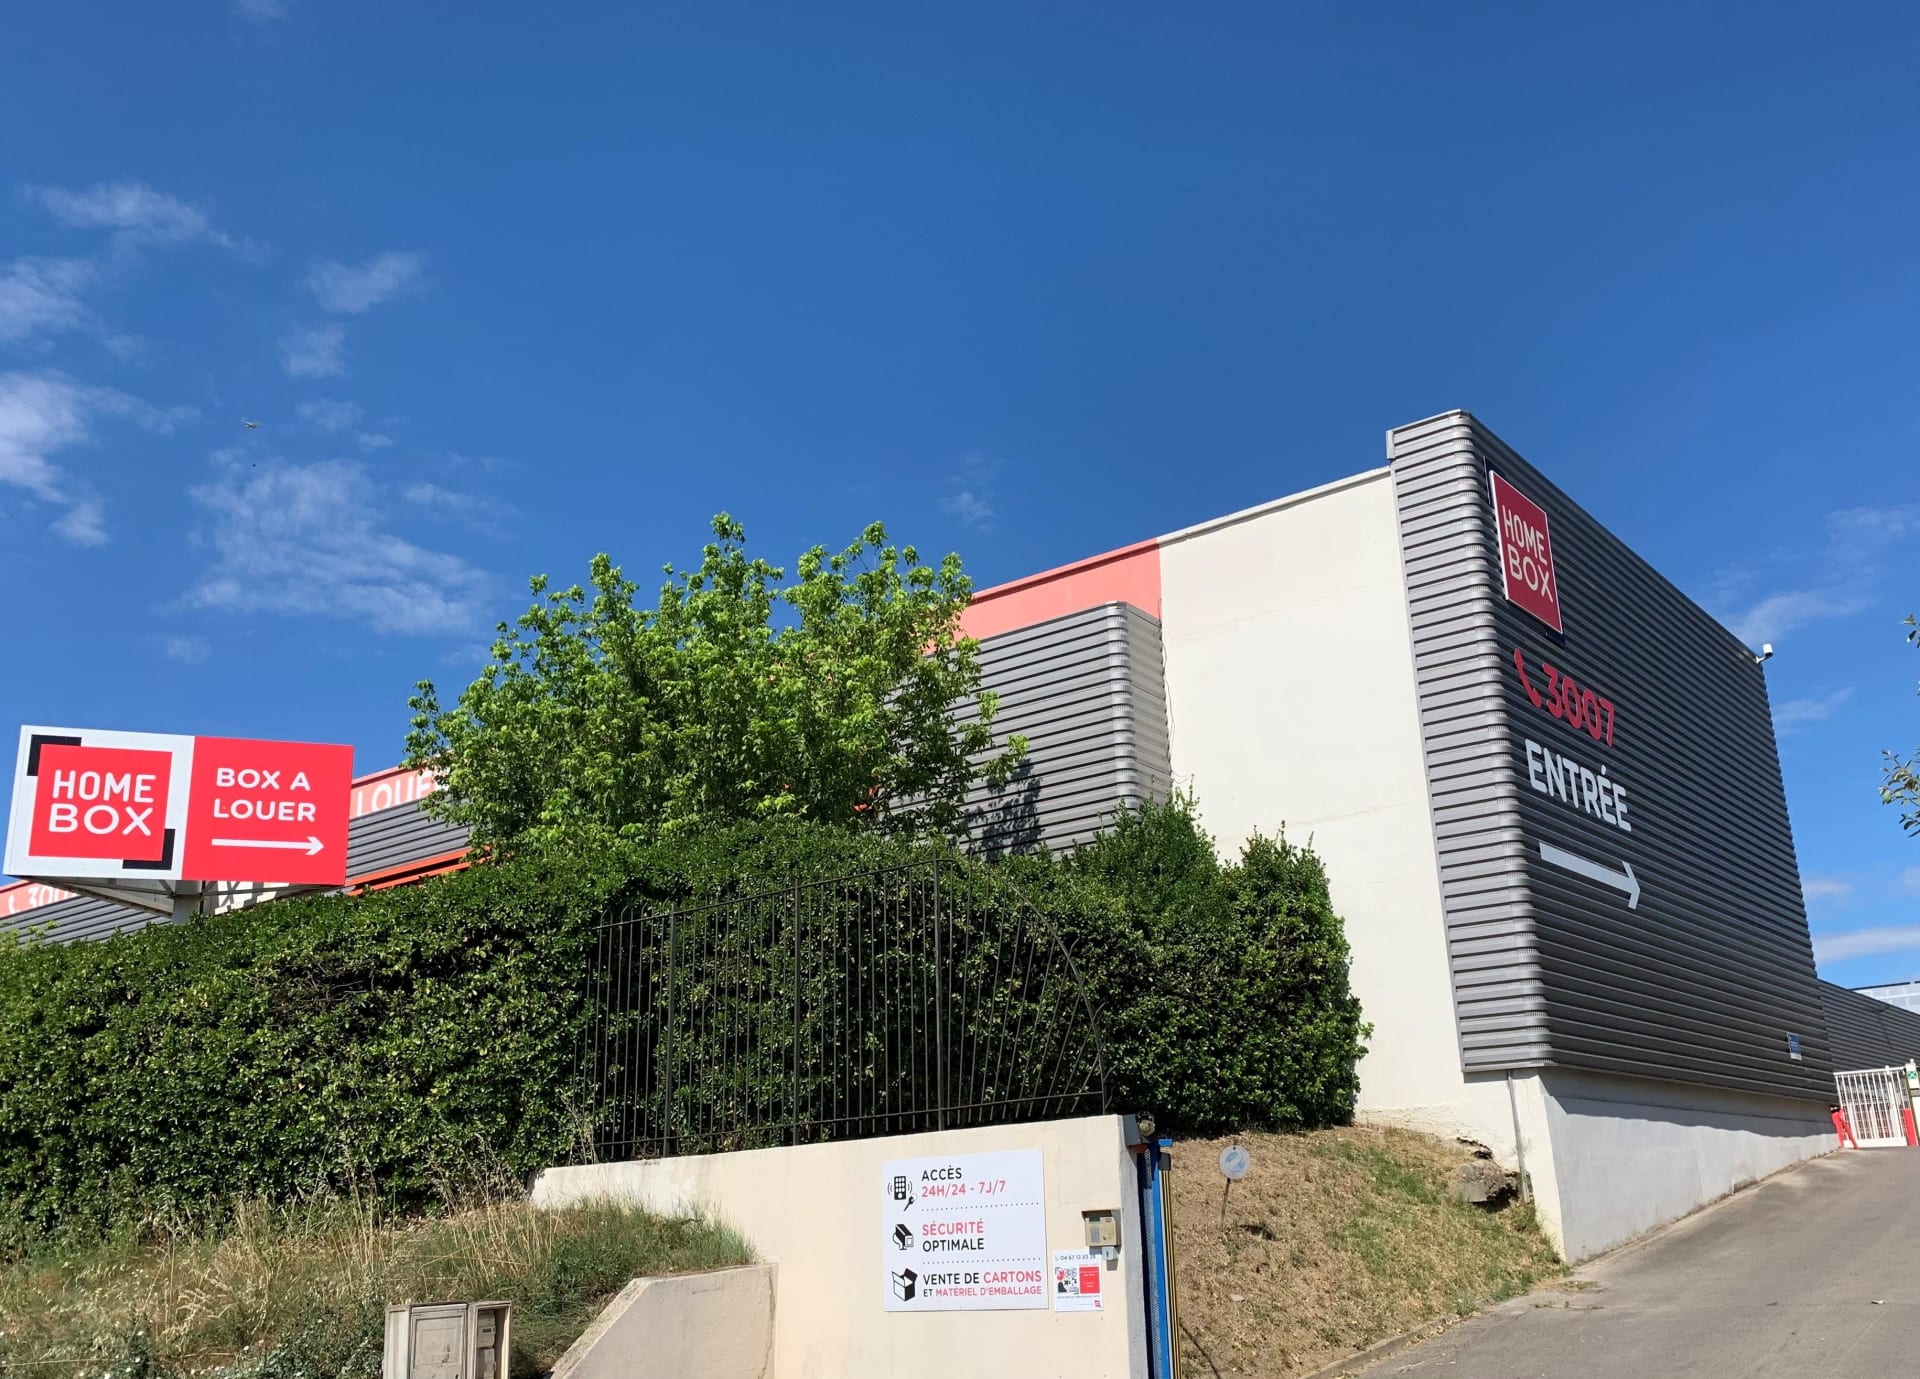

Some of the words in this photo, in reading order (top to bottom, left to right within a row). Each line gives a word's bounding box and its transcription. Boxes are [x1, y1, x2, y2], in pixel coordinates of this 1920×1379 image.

[1502, 504, 1548, 566] HOME
[1507, 543, 1554, 603] BOX
[1541, 662, 1616, 748] 3007
[52, 769, 157, 804] HOME
[216, 767, 281, 790] BOX
[290, 771, 311, 792] A
[1524, 738, 1632, 833] ENTRÉE
[356, 768, 450, 817] LOUE
[48, 803, 153, 837] BOX
[213, 798, 316, 822] LOUER
[921, 1164, 963, 1182] ACCÈS
[921, 1184, 967, 1199] 24H/24
[978, 1179, 1007, 1196] 7J/7
[922, 1217, 984, 1236] SÉCURITÉ
[922, 1238, 984, 1252] OPTIMALE
[923, 1273, 961, 1286] VENTE
[964, 1272, 980, 1284] DE
[983, 1270, 1042, 1284] CARTONS
[923, 1288, 933, 1298] ET
[980, 1285, 1042, 1297] D'EMBALLAGE
